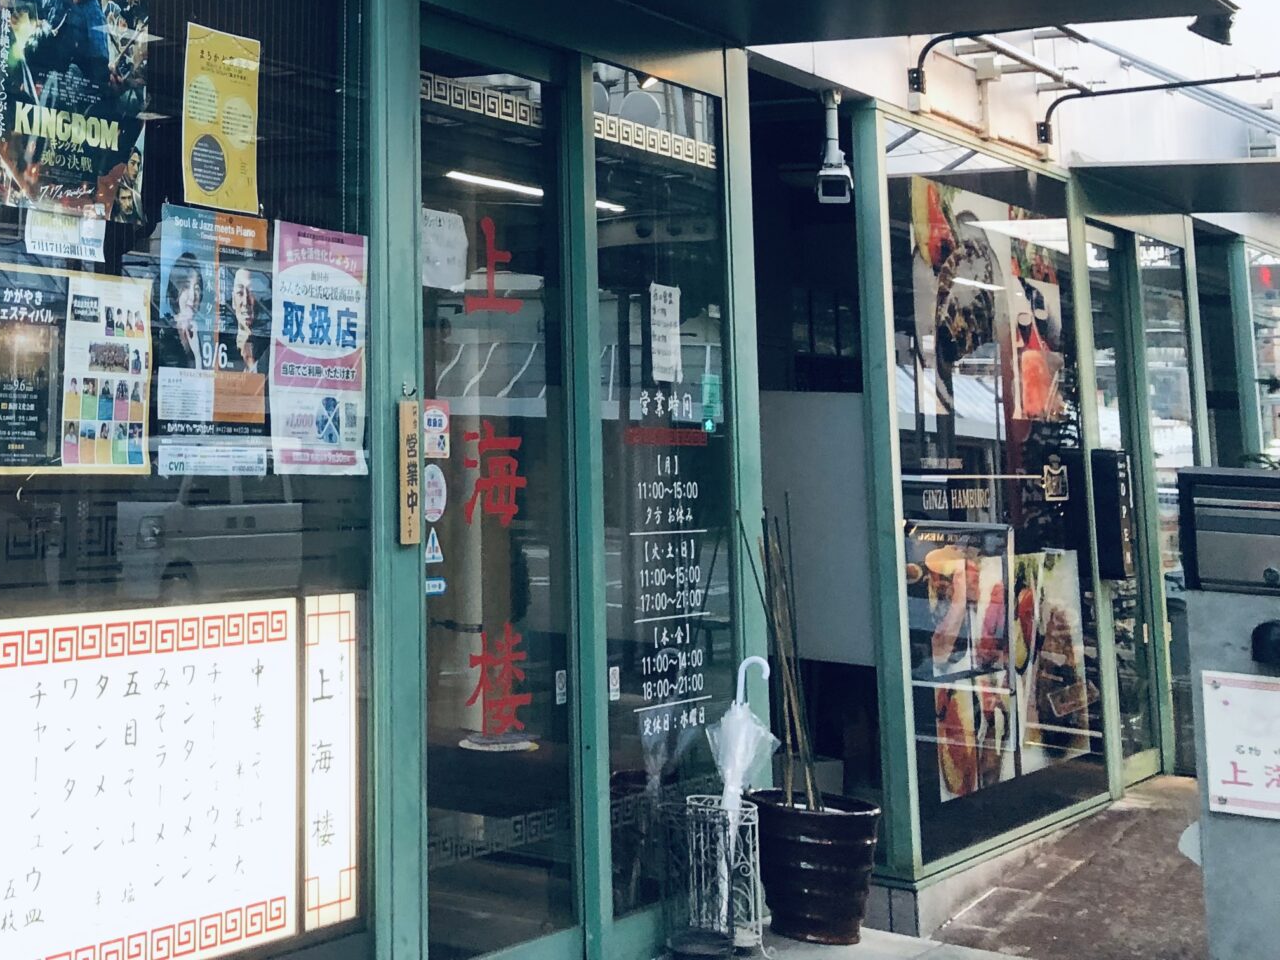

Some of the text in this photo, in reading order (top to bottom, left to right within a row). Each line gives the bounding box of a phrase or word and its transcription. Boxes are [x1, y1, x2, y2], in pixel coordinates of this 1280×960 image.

[15, 101, 119, 152] KINGDOM
[174, 215, 191, 229] Soul
[199, 219, 214, 232] Jazz
[214, 224, 235, 235] meets
[236, 225, 256, 238] Piano
[4, 288, 42, 305] かがやき
[283, 300, 358, 349] 取扱店
[202, 341, 228, 370] 9/6
[640, 390, 692, 419] 営業時間
[406, 433, 418, 515] 営業中
[464, 216, 532, 736] 上海楼
[922, 487, 990, 510] GINZA HAMBURG
[668, 505, 693, 524] お休み
[62, 677, 80, 855] ワンタン
[93, 673, 110, 852] タンメン
[153, 666, 170, 888] みそラーメン
[179, 664, 197, 880] ワンタンメン
[312, 667, 336, 848] 上海楼
